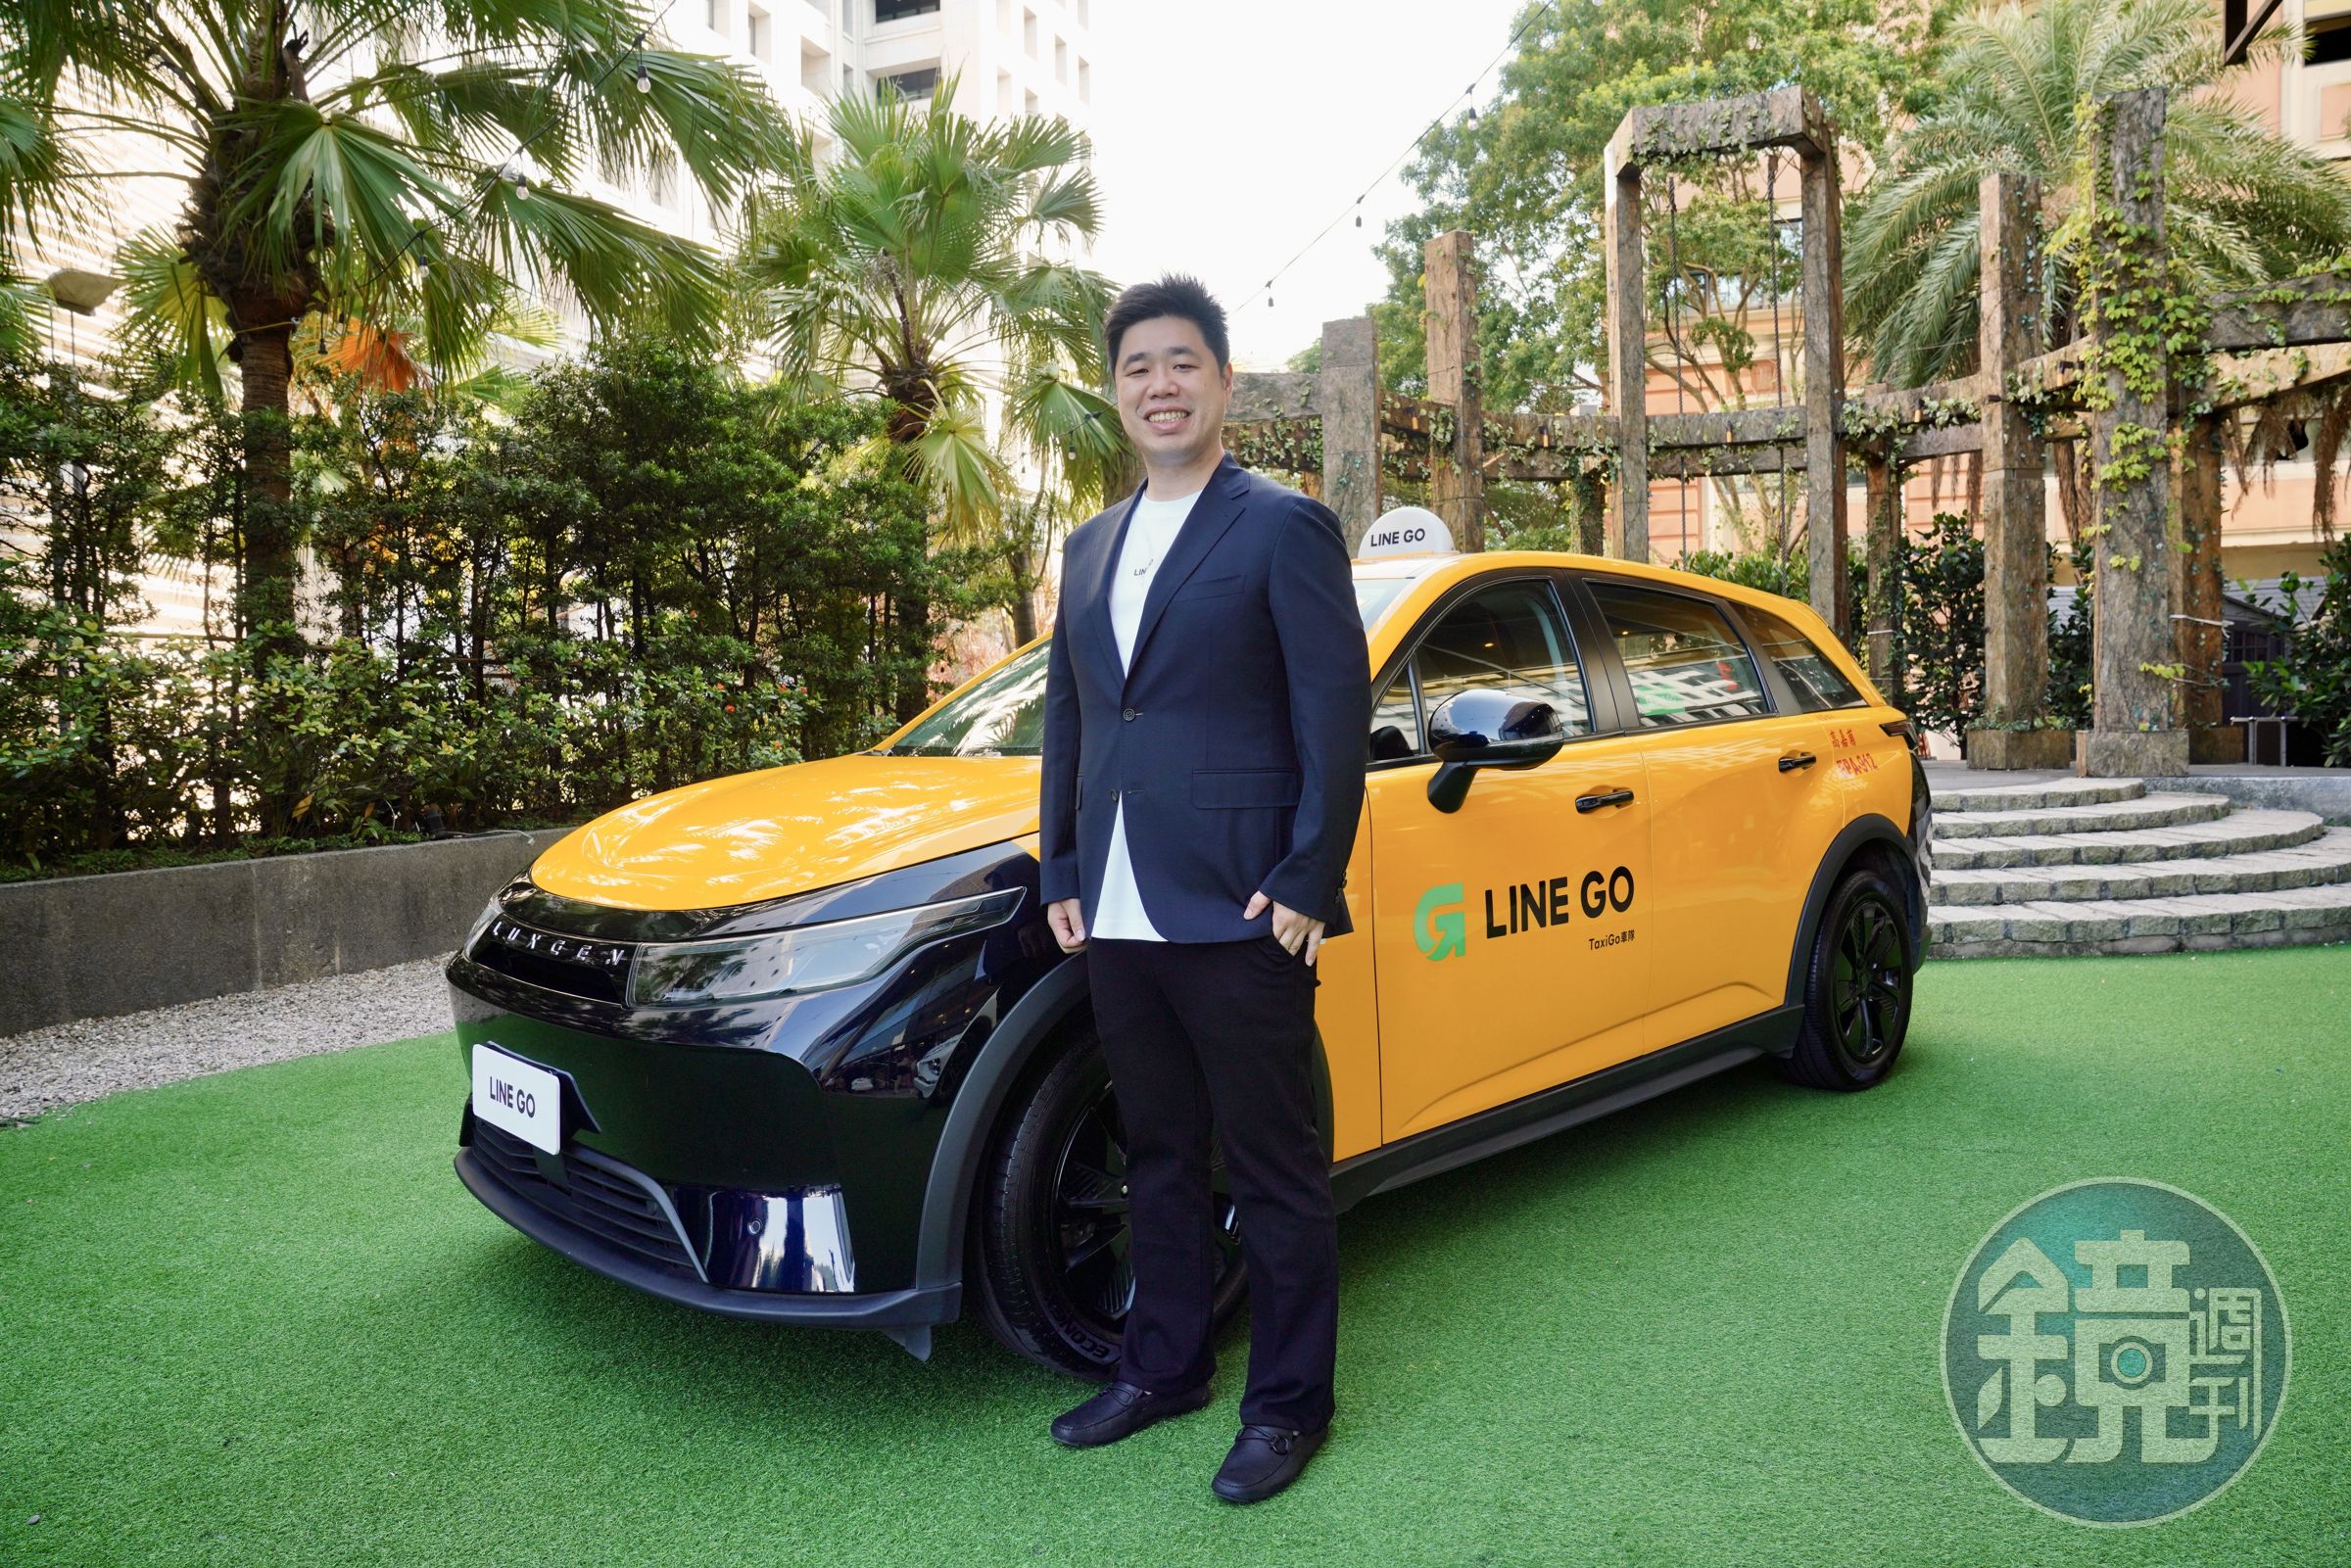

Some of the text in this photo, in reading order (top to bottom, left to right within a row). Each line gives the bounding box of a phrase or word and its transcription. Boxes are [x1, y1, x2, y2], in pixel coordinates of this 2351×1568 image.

[1370, 528, 1425, 547] LINE GO
[1133, 566, 1148, 577] LIN
[1485, 866, 1635, 939] LINE GO
[493, 921, 625, 967] LUXGEN
[490, 1075, 536, 1118] LINE GO
